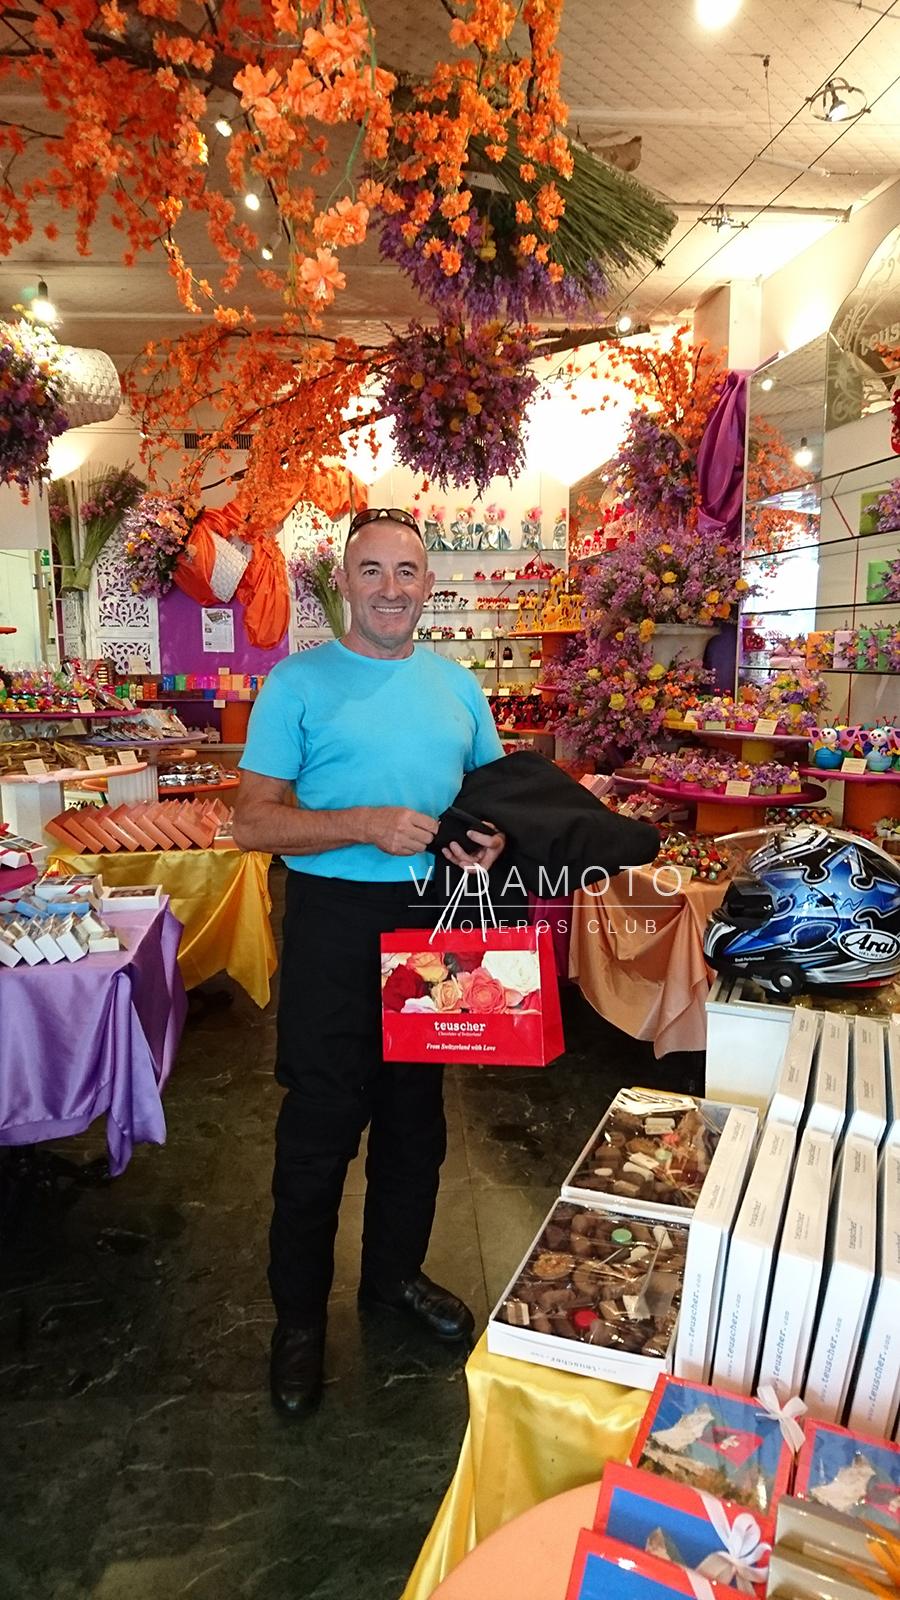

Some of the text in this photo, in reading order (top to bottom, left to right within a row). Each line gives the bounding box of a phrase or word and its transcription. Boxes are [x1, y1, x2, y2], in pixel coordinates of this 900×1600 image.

[844, 933, 895, 954] Arai
[434, 1021, 486, 1032] teuscher
[441, 1043, 471, 1051] Switzerland
[483, 1044, 497, 1052] Love
